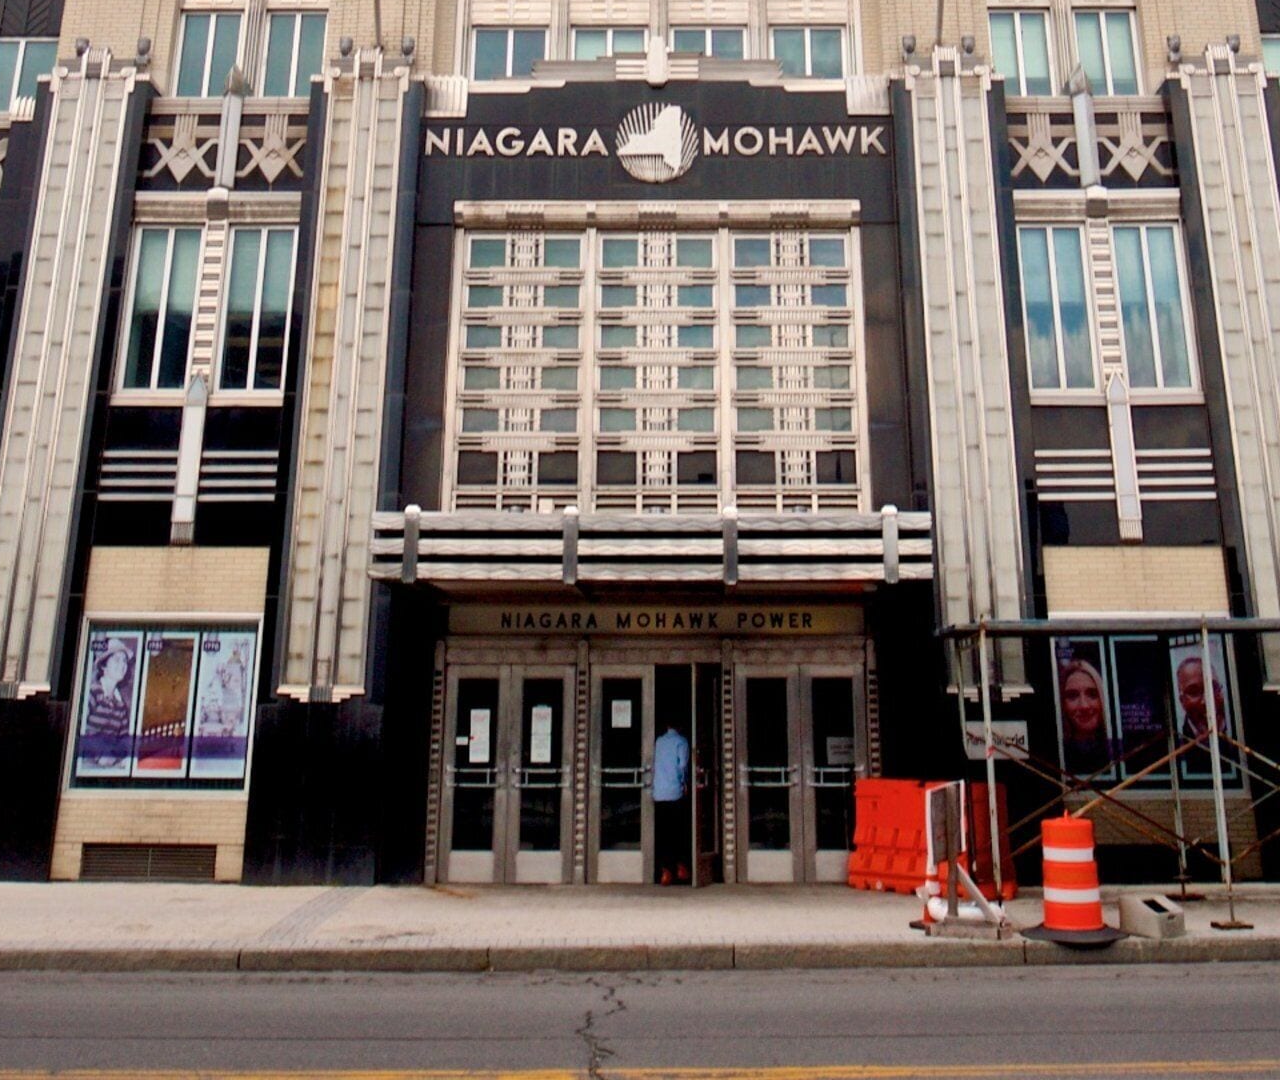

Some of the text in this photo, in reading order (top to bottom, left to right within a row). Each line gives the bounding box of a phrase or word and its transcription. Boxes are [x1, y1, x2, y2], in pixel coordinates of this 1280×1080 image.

[425, 126, 886, 158] NIAGARA MOHAWK
[501, 612, 814, 629] NIAGARA MOHAWK POWER
